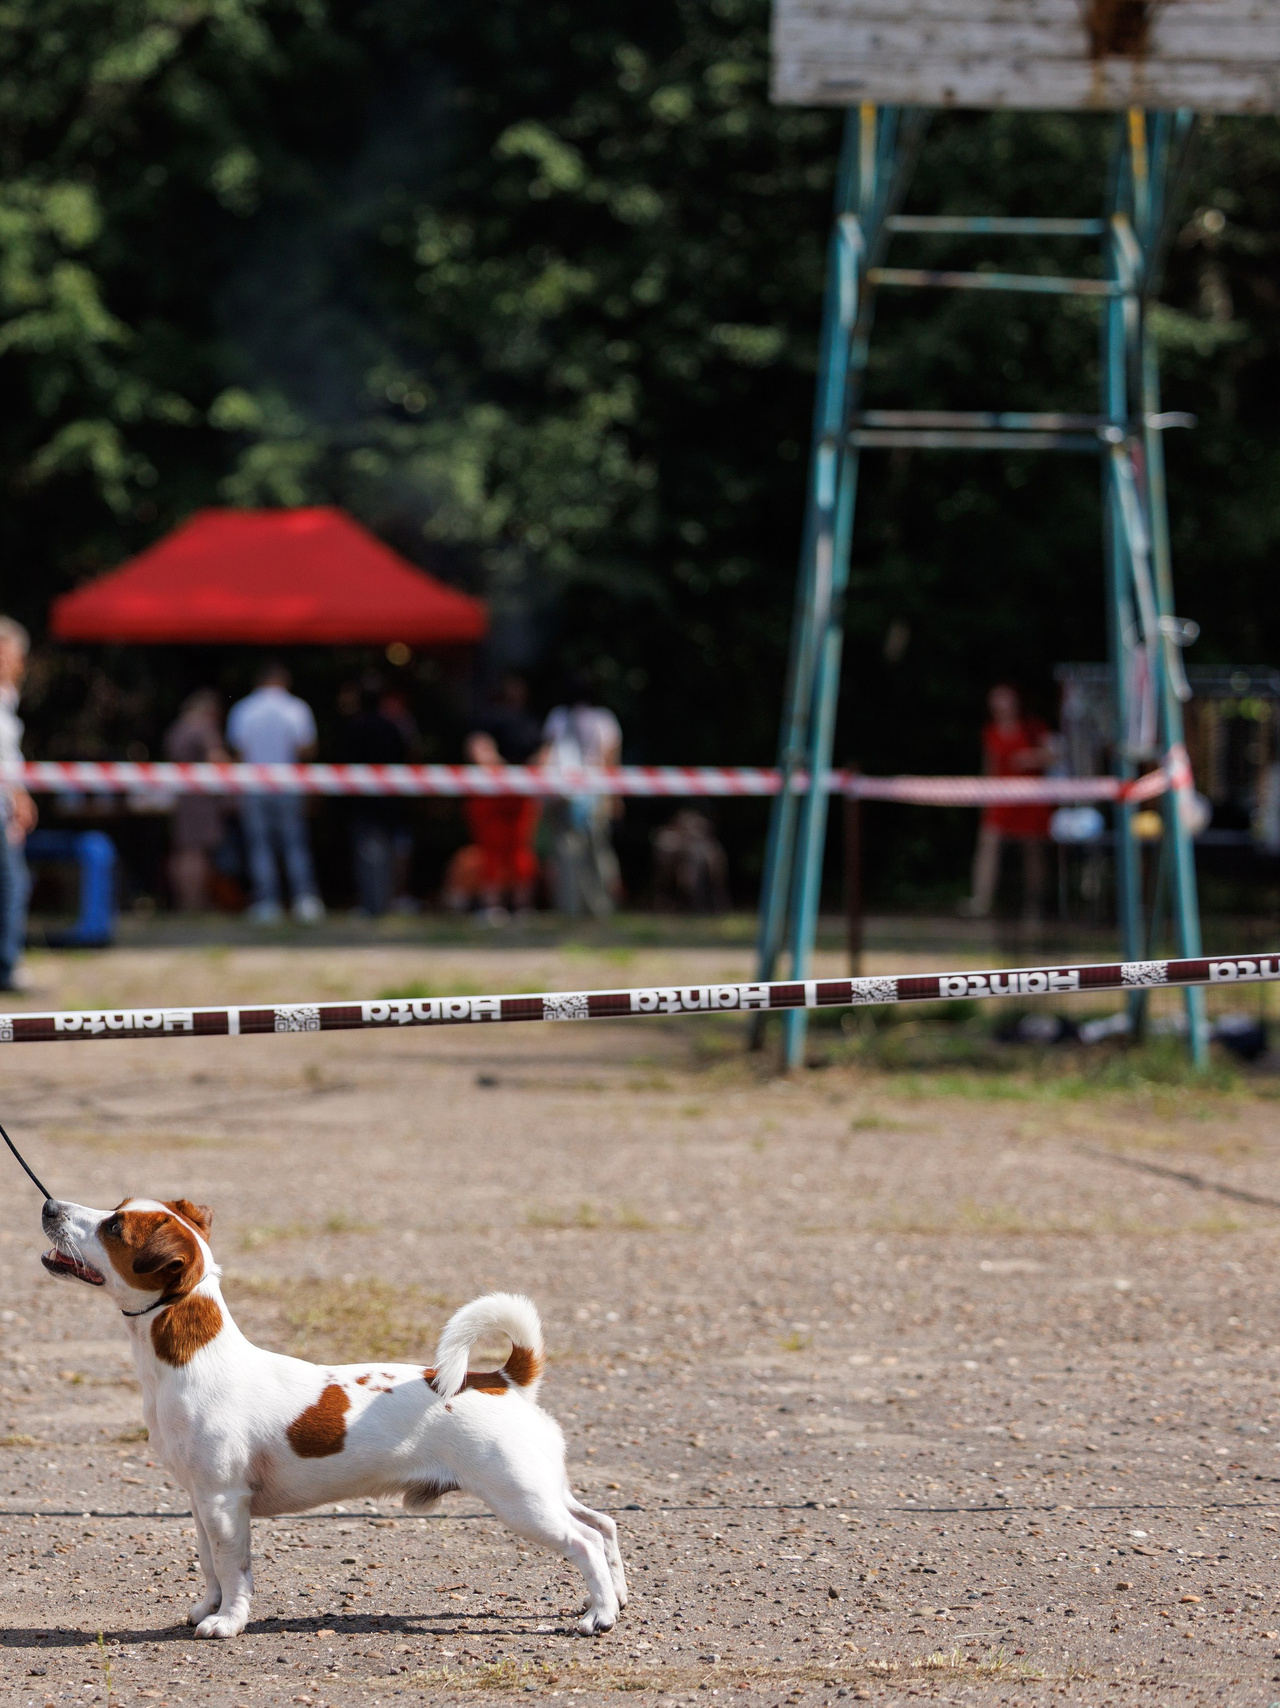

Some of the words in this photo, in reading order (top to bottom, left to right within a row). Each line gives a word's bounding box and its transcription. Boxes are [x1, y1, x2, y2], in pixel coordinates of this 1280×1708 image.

[939, 970, 1080, 997] Hanta
[361, 1000, 502, 1025] Hanta
[630, 986, 770, 1013] Hanta
[55, 1011, 194, 1035] Hanta
